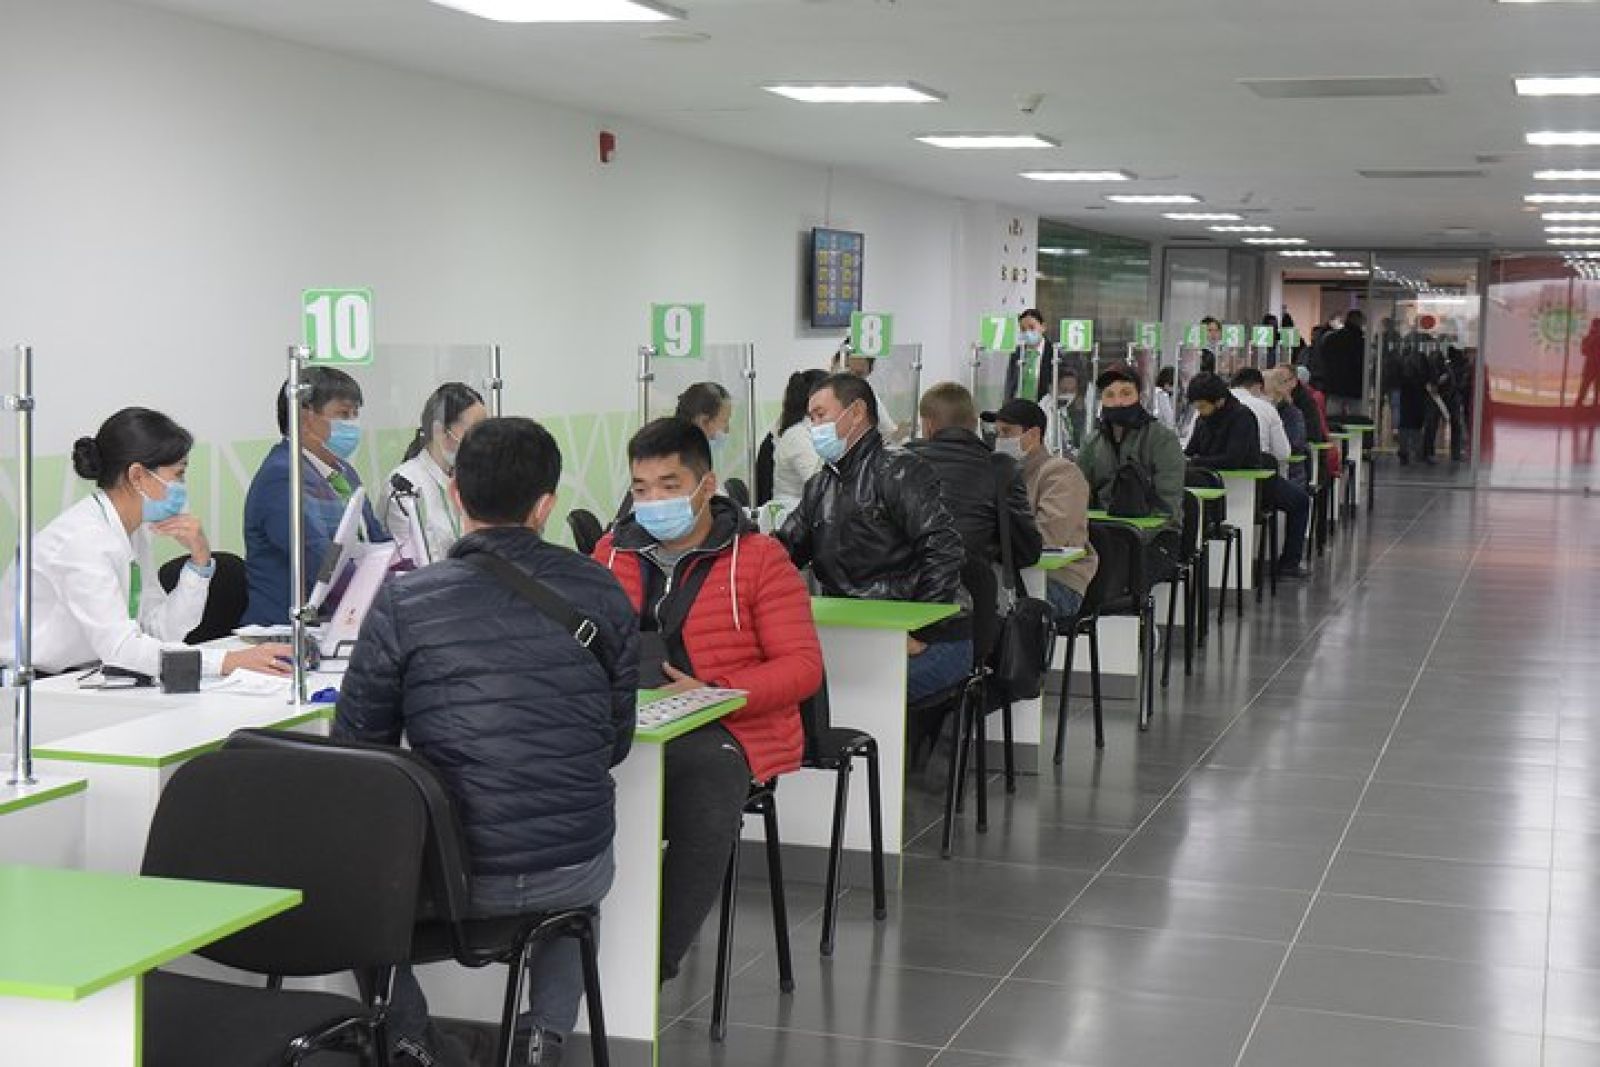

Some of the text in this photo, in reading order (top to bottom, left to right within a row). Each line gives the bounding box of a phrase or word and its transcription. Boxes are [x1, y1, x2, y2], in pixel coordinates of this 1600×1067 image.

[306, 295, 370, 359] 10
[664, 306, 692, 357] 9
[859, 315, 883, 355] 8
[990, 318, 1006, 350] 7
[1068, 321, 1085, 347] 6
[1141, 322, 1156, 347] 5
[1187, 325, 1200, 346] 4
[1226, 326, 1239, 346] 3
[1257, 327, 1269, 346] 2
